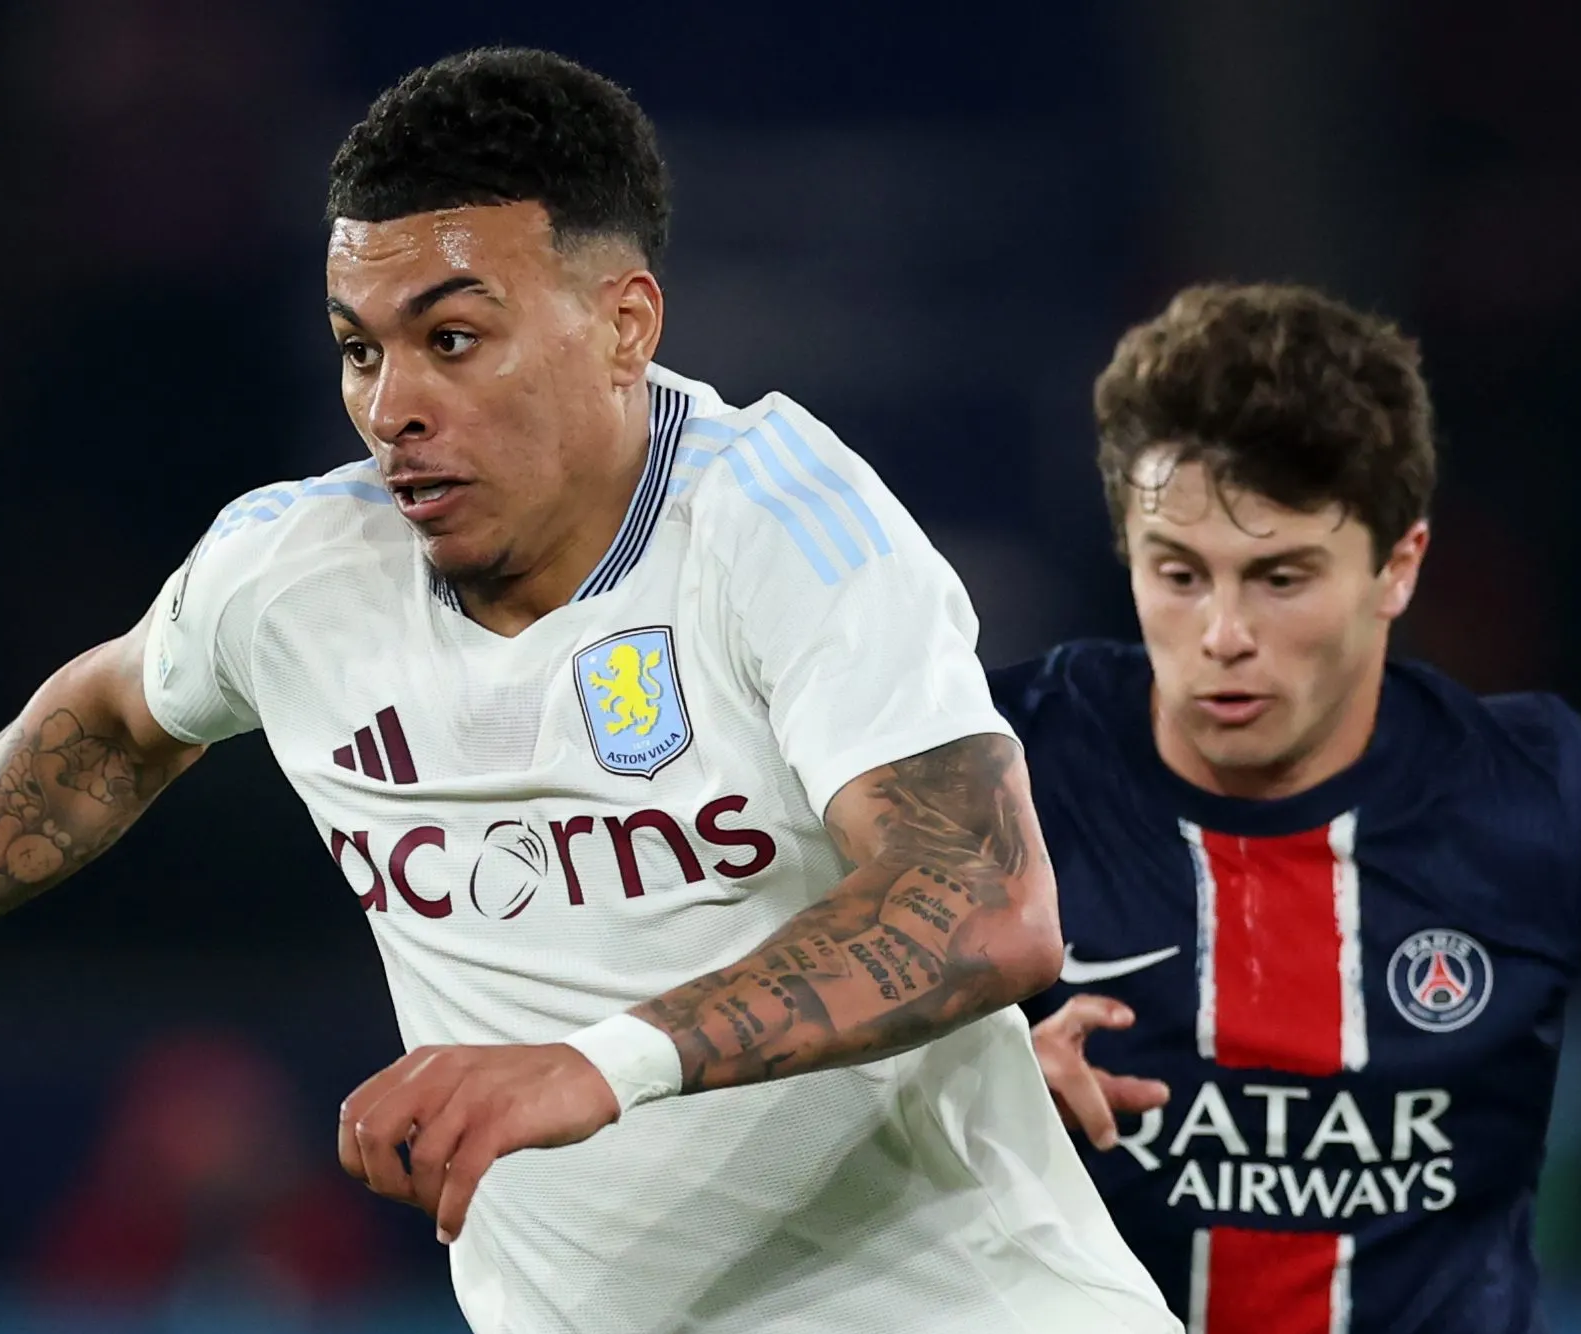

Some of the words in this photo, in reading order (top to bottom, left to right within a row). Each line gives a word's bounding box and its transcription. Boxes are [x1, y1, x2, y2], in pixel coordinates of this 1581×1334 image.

[607, 751, 647, 765] ASTON
[648, 732, 680, 758] VILLA
[331, 794, 777, 919] acorns
[1167, 1157, 1457, 1219] AIRWAYS
